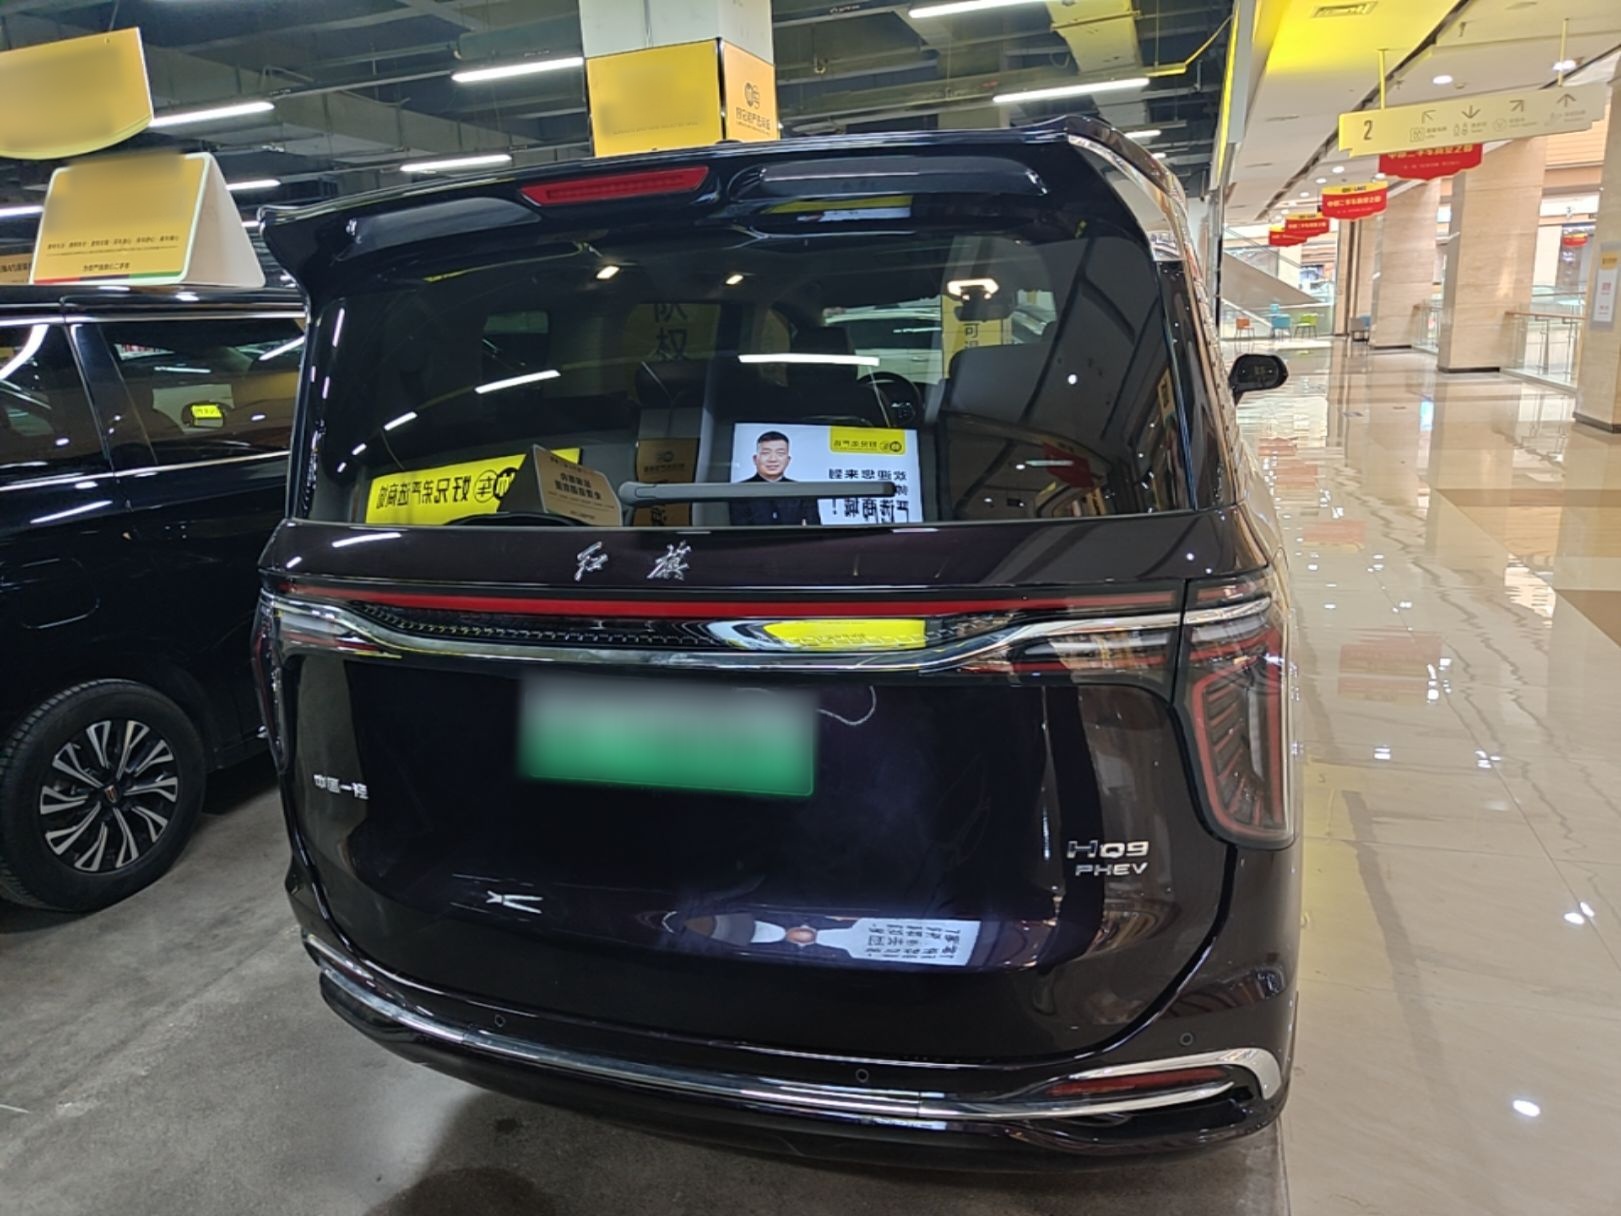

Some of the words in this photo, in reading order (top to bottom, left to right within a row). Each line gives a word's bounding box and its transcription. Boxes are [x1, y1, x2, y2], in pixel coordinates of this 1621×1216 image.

[1363, 119, 1374, 140] 2
[573, 540, 692, 582] 红旗
[1066, 839, 1150, 859] HQ9
[1074, 862, 1149, 877] PHEV
